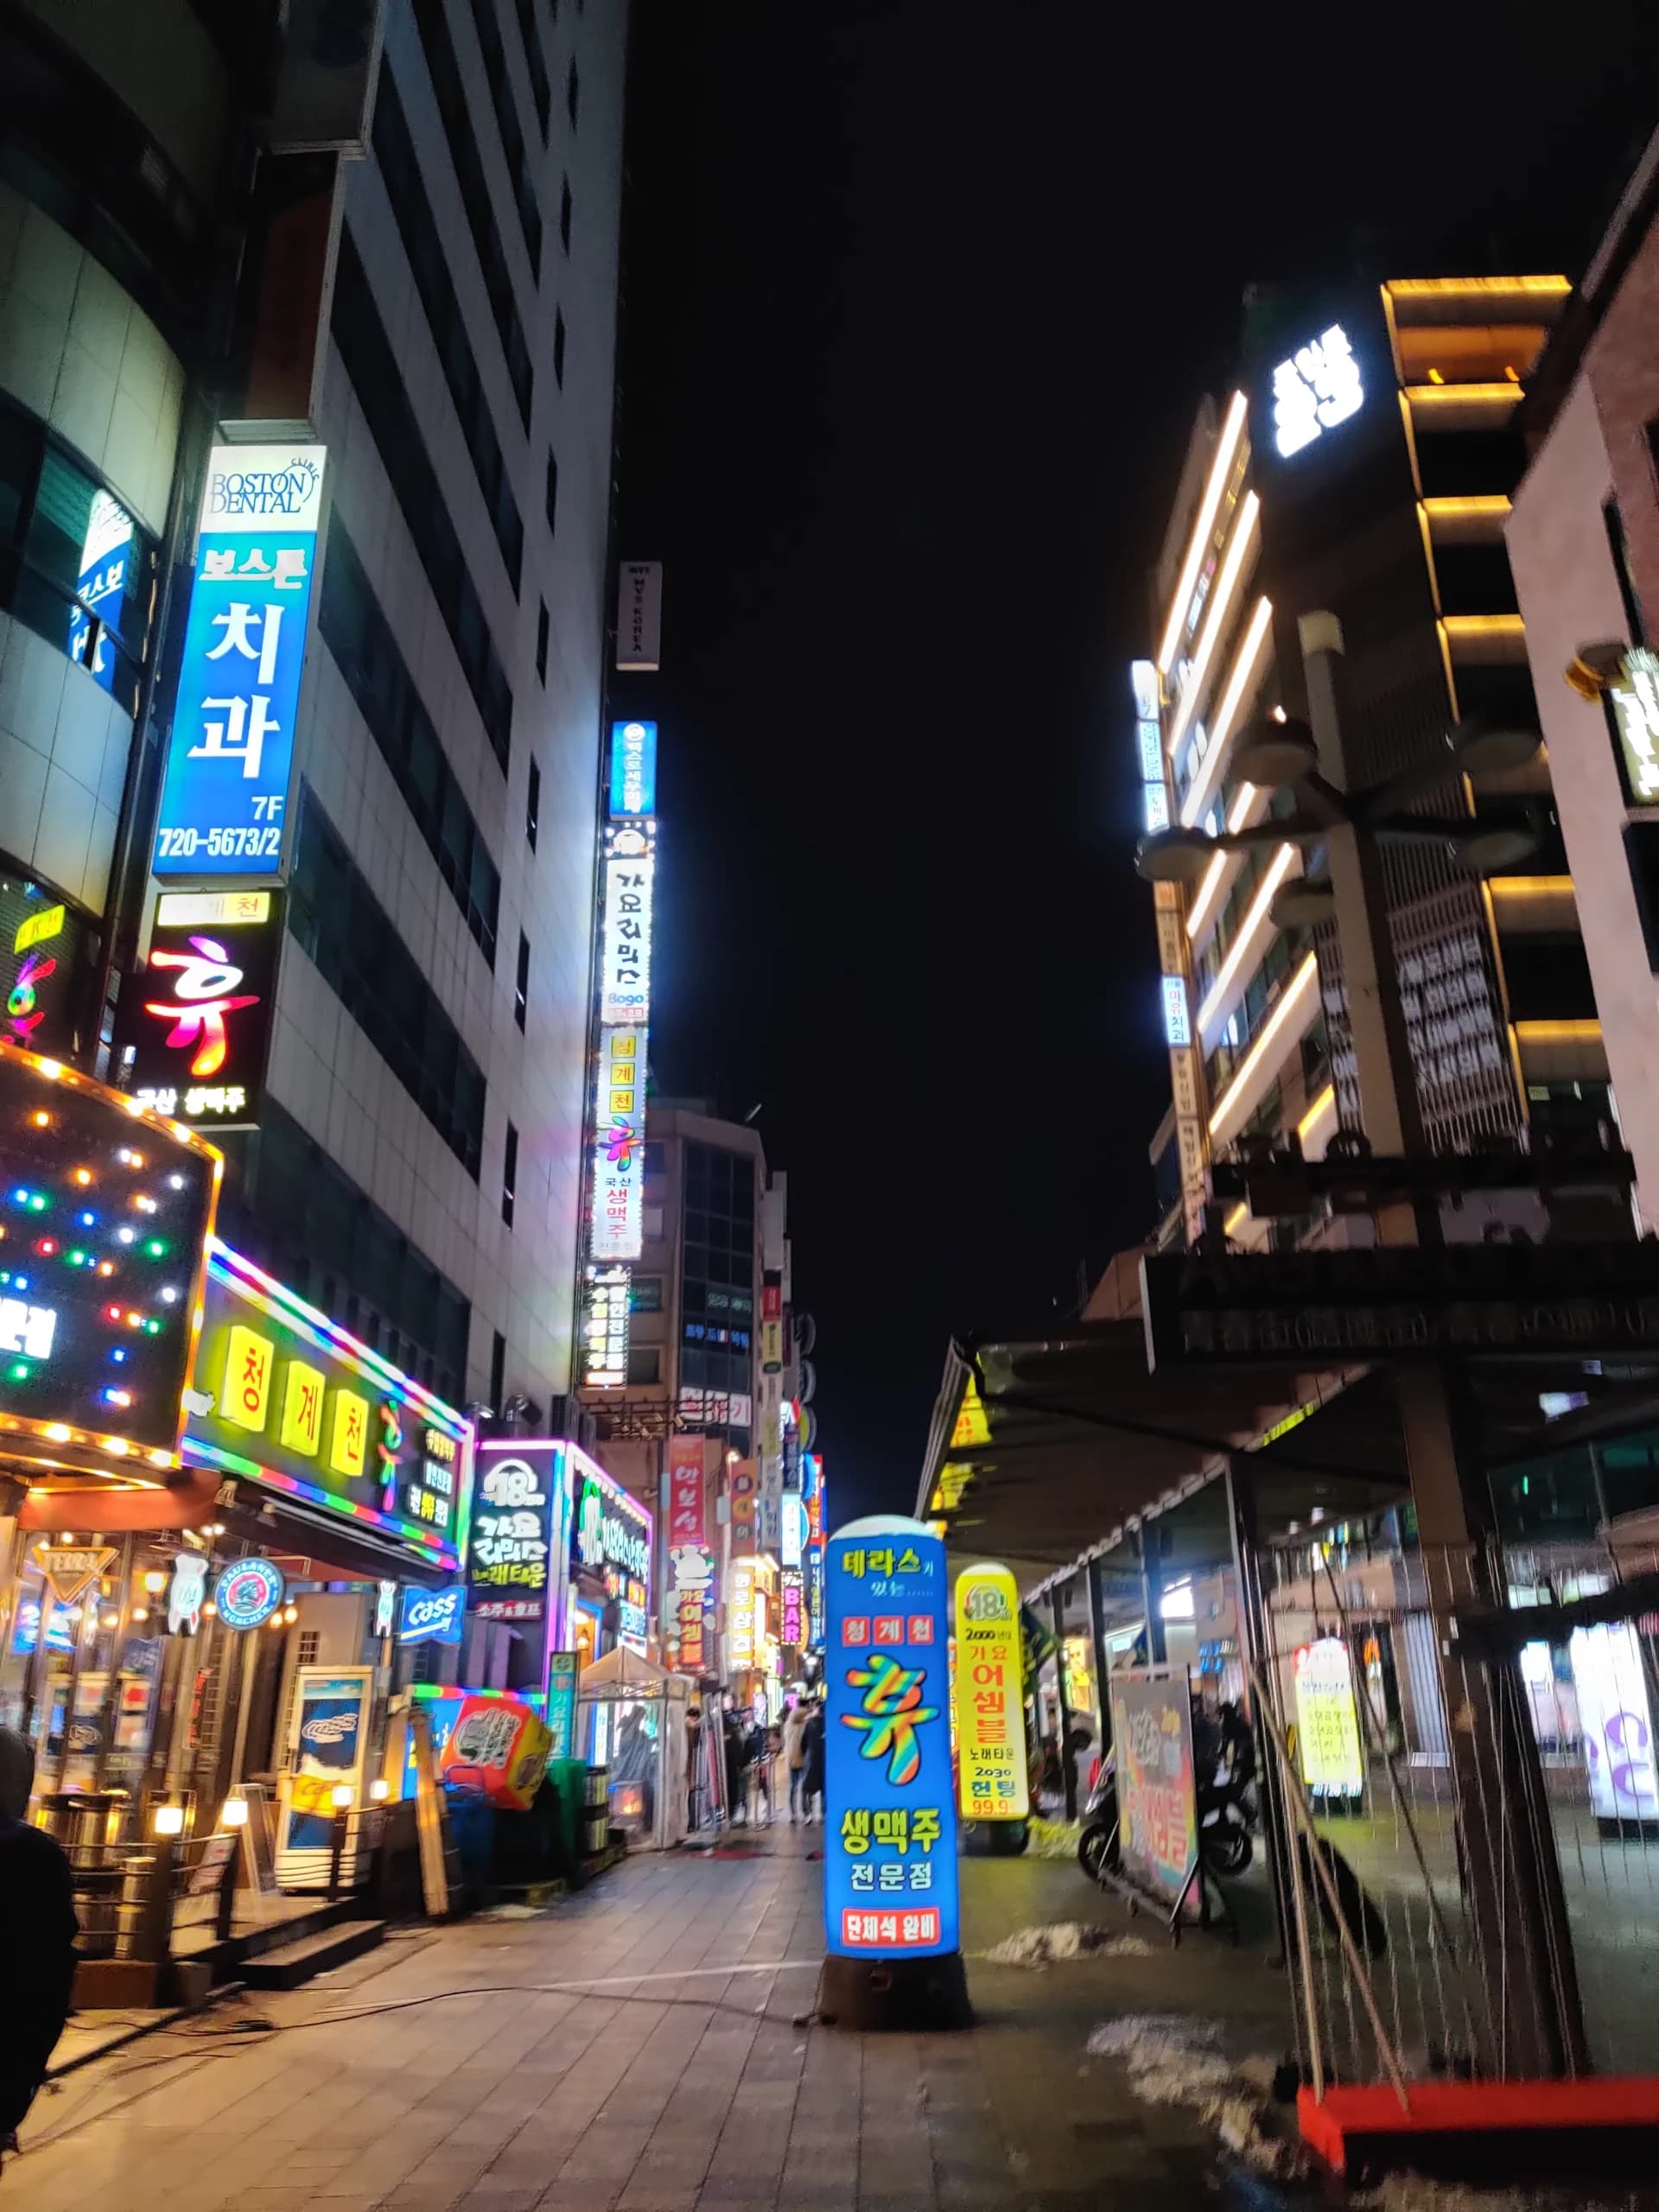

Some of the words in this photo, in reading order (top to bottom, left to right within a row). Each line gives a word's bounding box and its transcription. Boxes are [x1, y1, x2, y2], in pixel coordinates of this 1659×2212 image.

[211, 474, 307, 495] BOSTON
[209, 492, 302, 514] DENTAL
[200, 548, 308, 589] 보스톤
[187, 602, 286, 779] 치과
[251, 796, 284, 821] 7F
[158, 828, 280, 857] 720-5673/2
[614, 1039, 632, 1109] 청계천
[604, 1177, 632, 1188] 국산
[606, 1189, 628, 1239] 생맥주
[243, 1346, 361, 1461] 청계천
[476, 1511, 541, 1539] 가요
[221, 1562, 278, 1588] PAULANER
[472, 1563, 547, 1589] 노래타운
[784, 1588, 800, 1643] BAR
[971, 1592, 1000, 1618] 18
[846, 1619, 931, 1643] 청계천
[969, 1644, 1008, 1661] 가요
[972, 1663, 1007, 1745] 어셈블
[969, 1748, 1015, 1761] 노래타운
[975, 1767, 1012, 1778] 2030
[970, 1780, 1016, 1798] 헌팅
[840, 1807, 941, 1856] 생맥주
[850, 1861, 933, 1891] 전문점
[847, 1914, 897, 1943] 단체석
[902, 1911, 935, 1942] 완비
